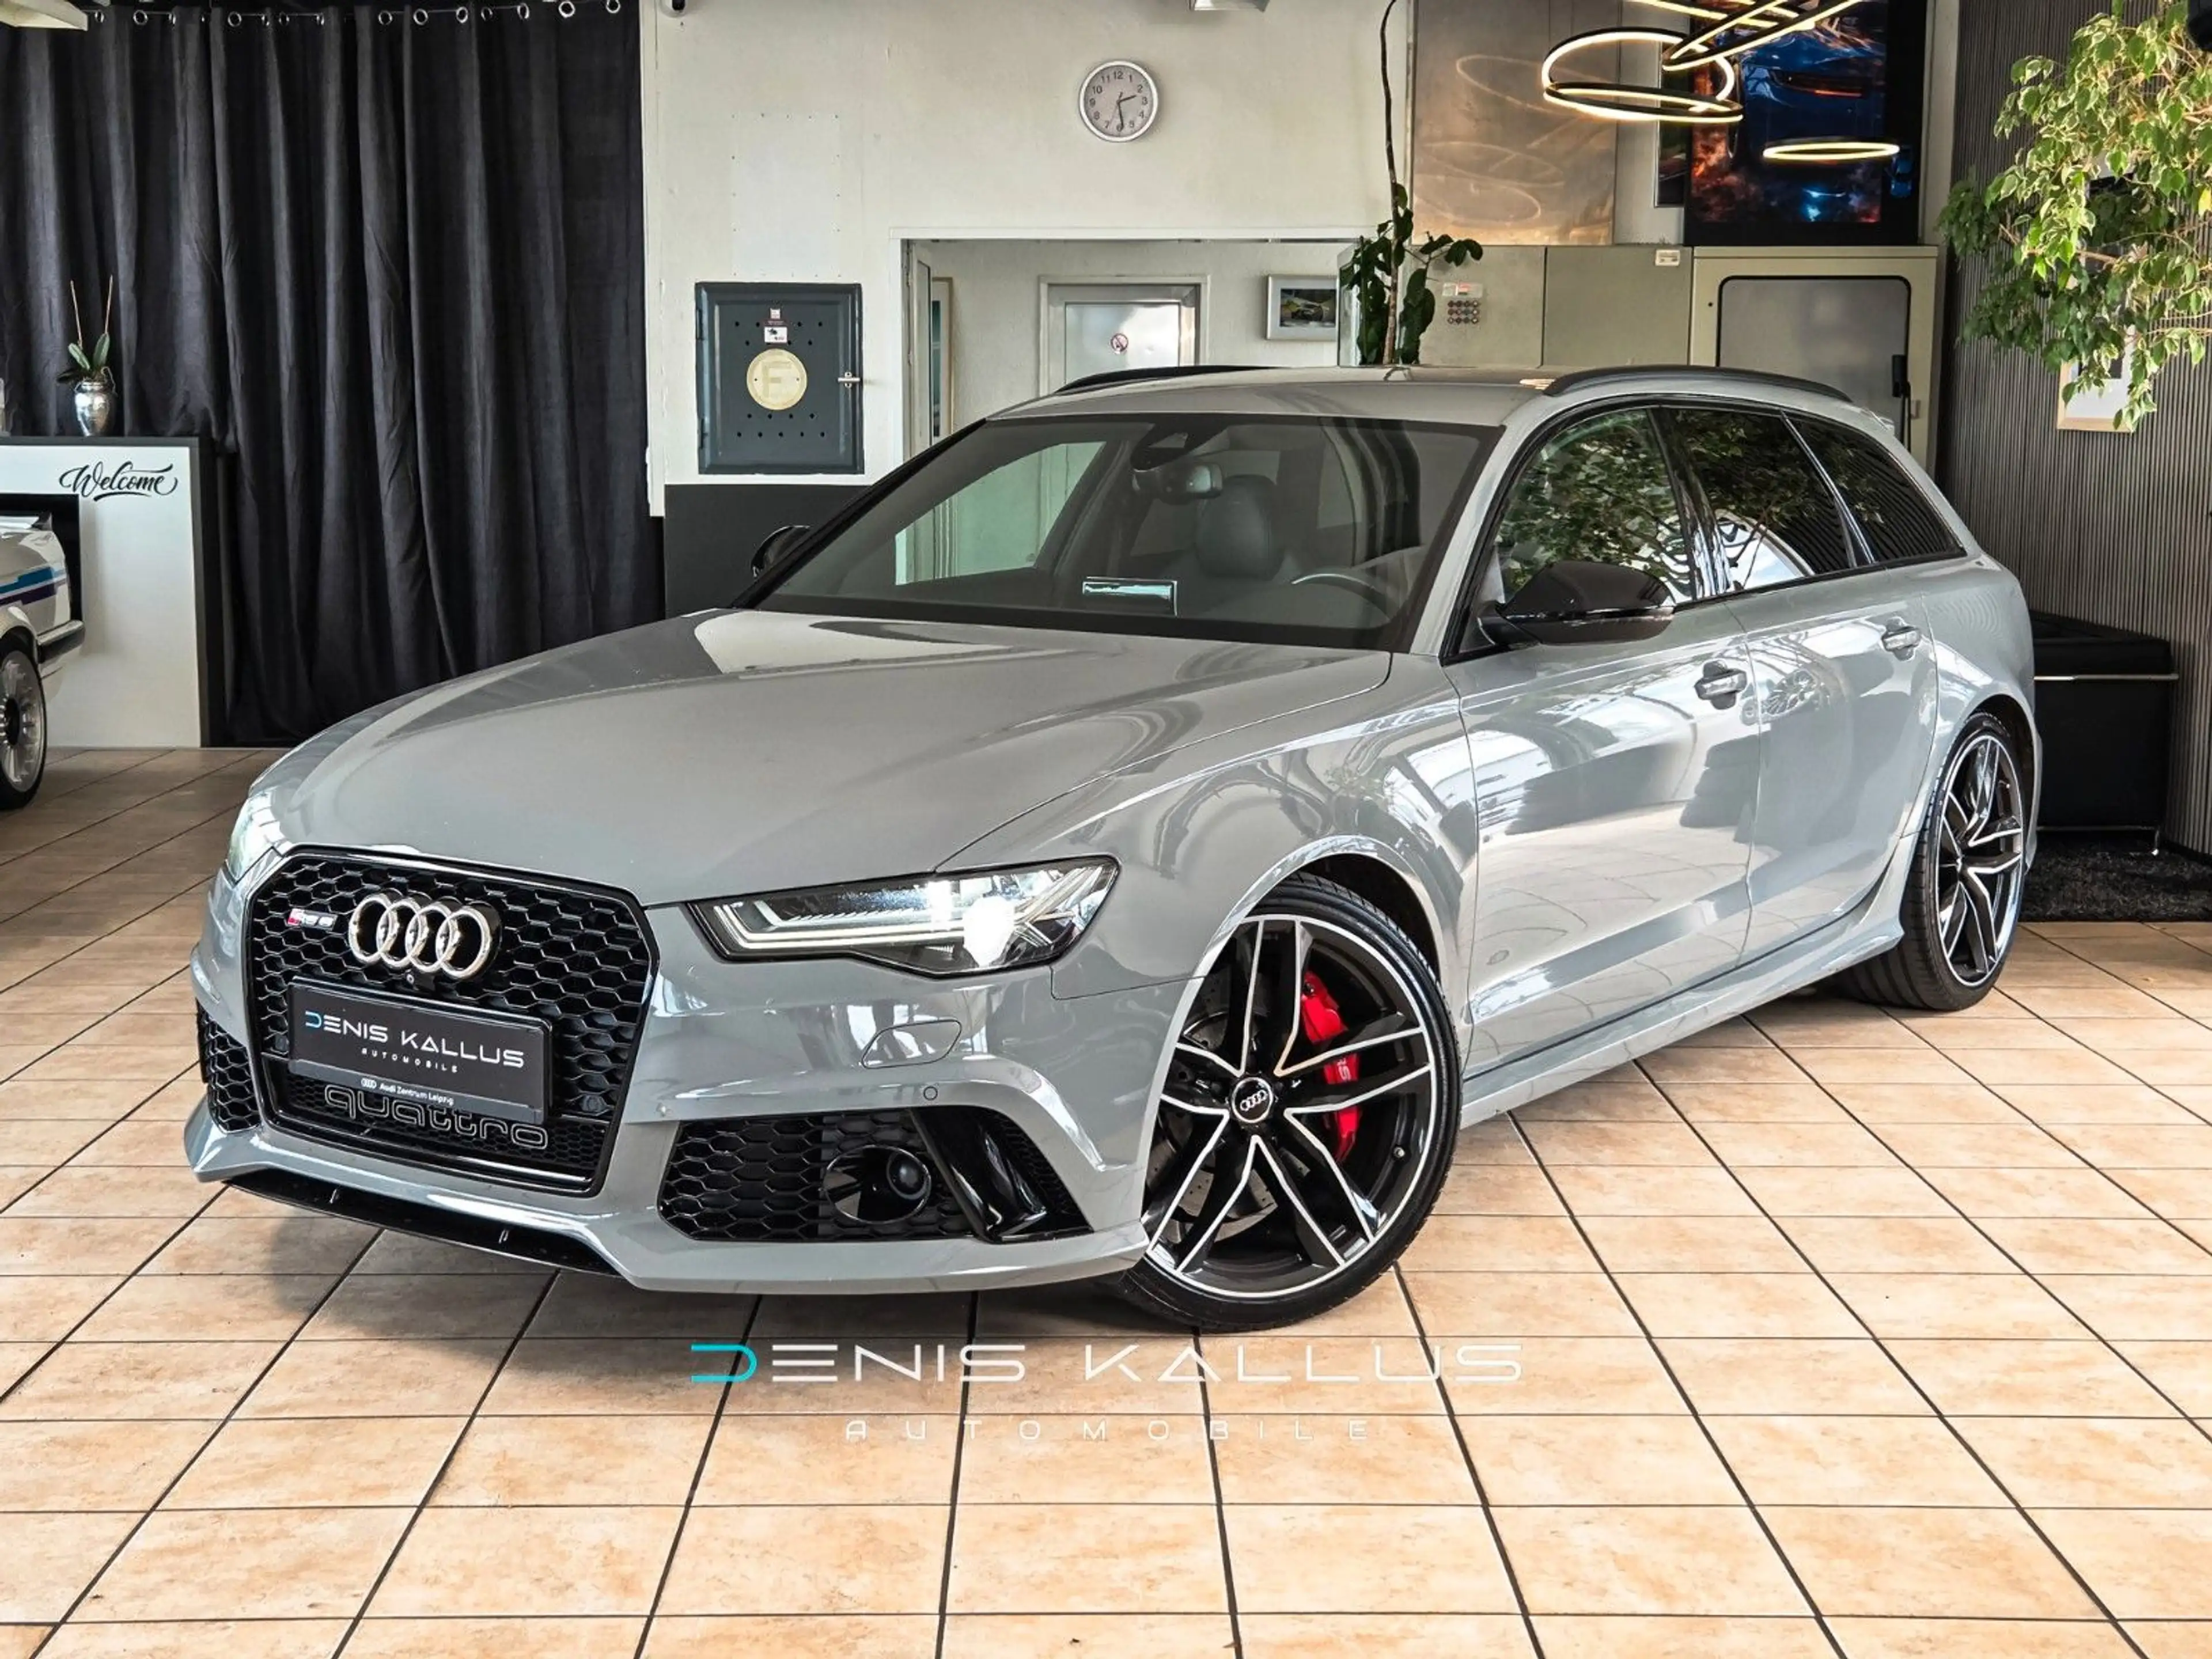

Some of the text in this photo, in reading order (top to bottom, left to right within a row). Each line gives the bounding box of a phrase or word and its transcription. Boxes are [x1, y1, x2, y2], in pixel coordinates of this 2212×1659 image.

[1114, 70, 1123, 79] 12
[1093, 85, 1103, 94] 10
[1137, 84, 1143, 93] 2
[1142, 96, 1147, 105] 3
[59, 460, 178, 502] Welcome
[305, 1010, 524, 1069] DENIS KALLUS
[361, 1047, 458, 1074] AUTOMOBILE
[379, 1082, 396, 1093] Audi
[396, 1086, 428, 1100] Zentrum
[324, 1084, 548, 1150] quattro
